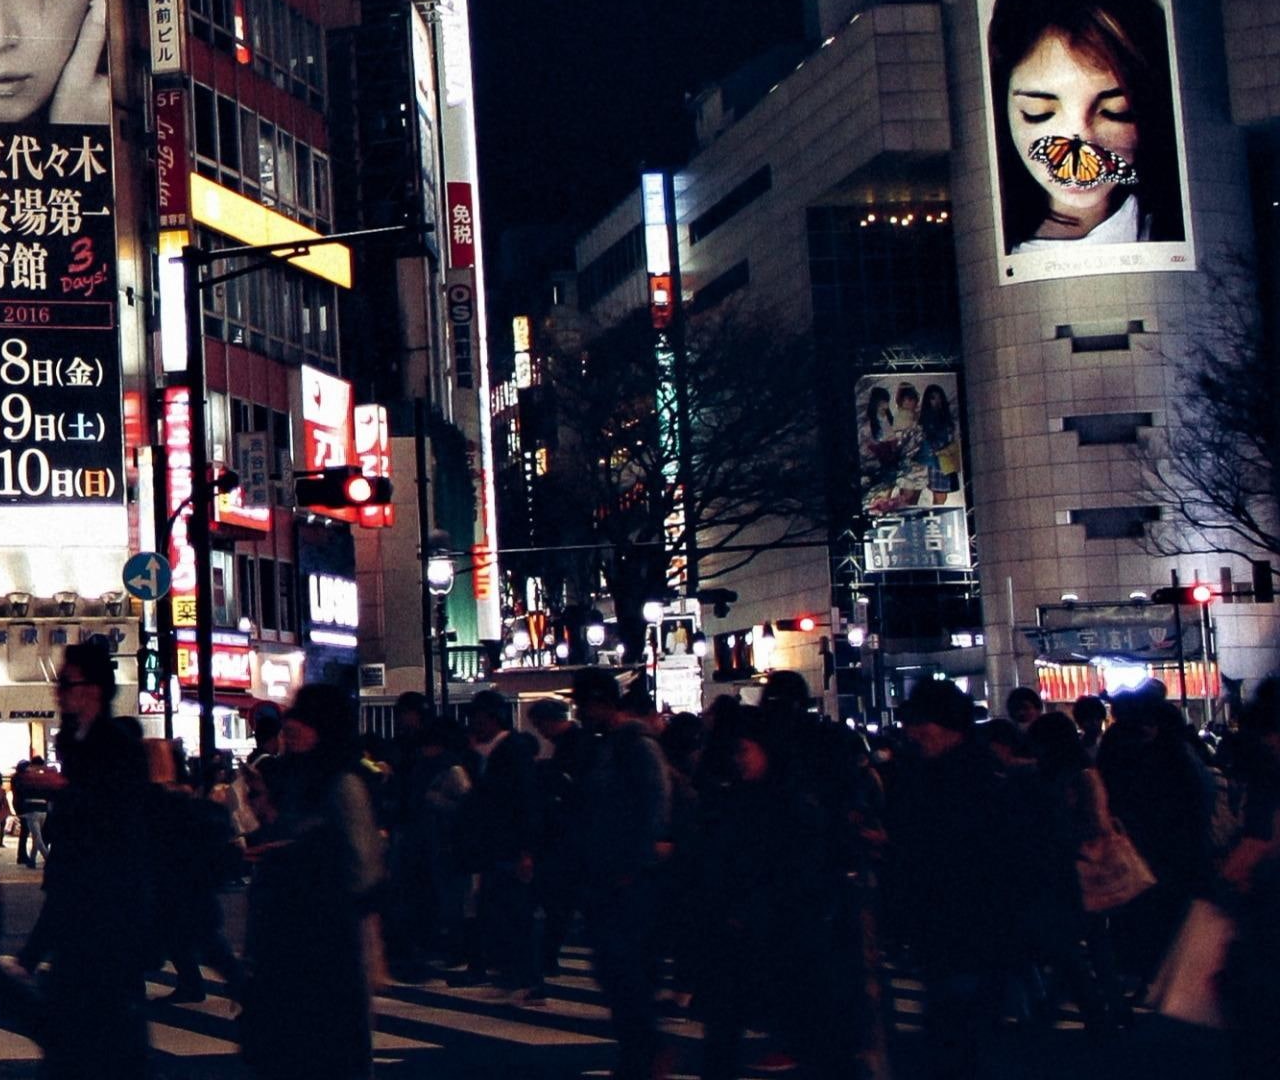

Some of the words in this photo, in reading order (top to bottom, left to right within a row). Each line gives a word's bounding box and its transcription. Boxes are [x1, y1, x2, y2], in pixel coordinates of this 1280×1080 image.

[452, 204, 473, 245] 免税
[68, 236, 96, 273] 3
[60, 263, 109, 297] Days!
[3, 306, 51, 323] 2016
